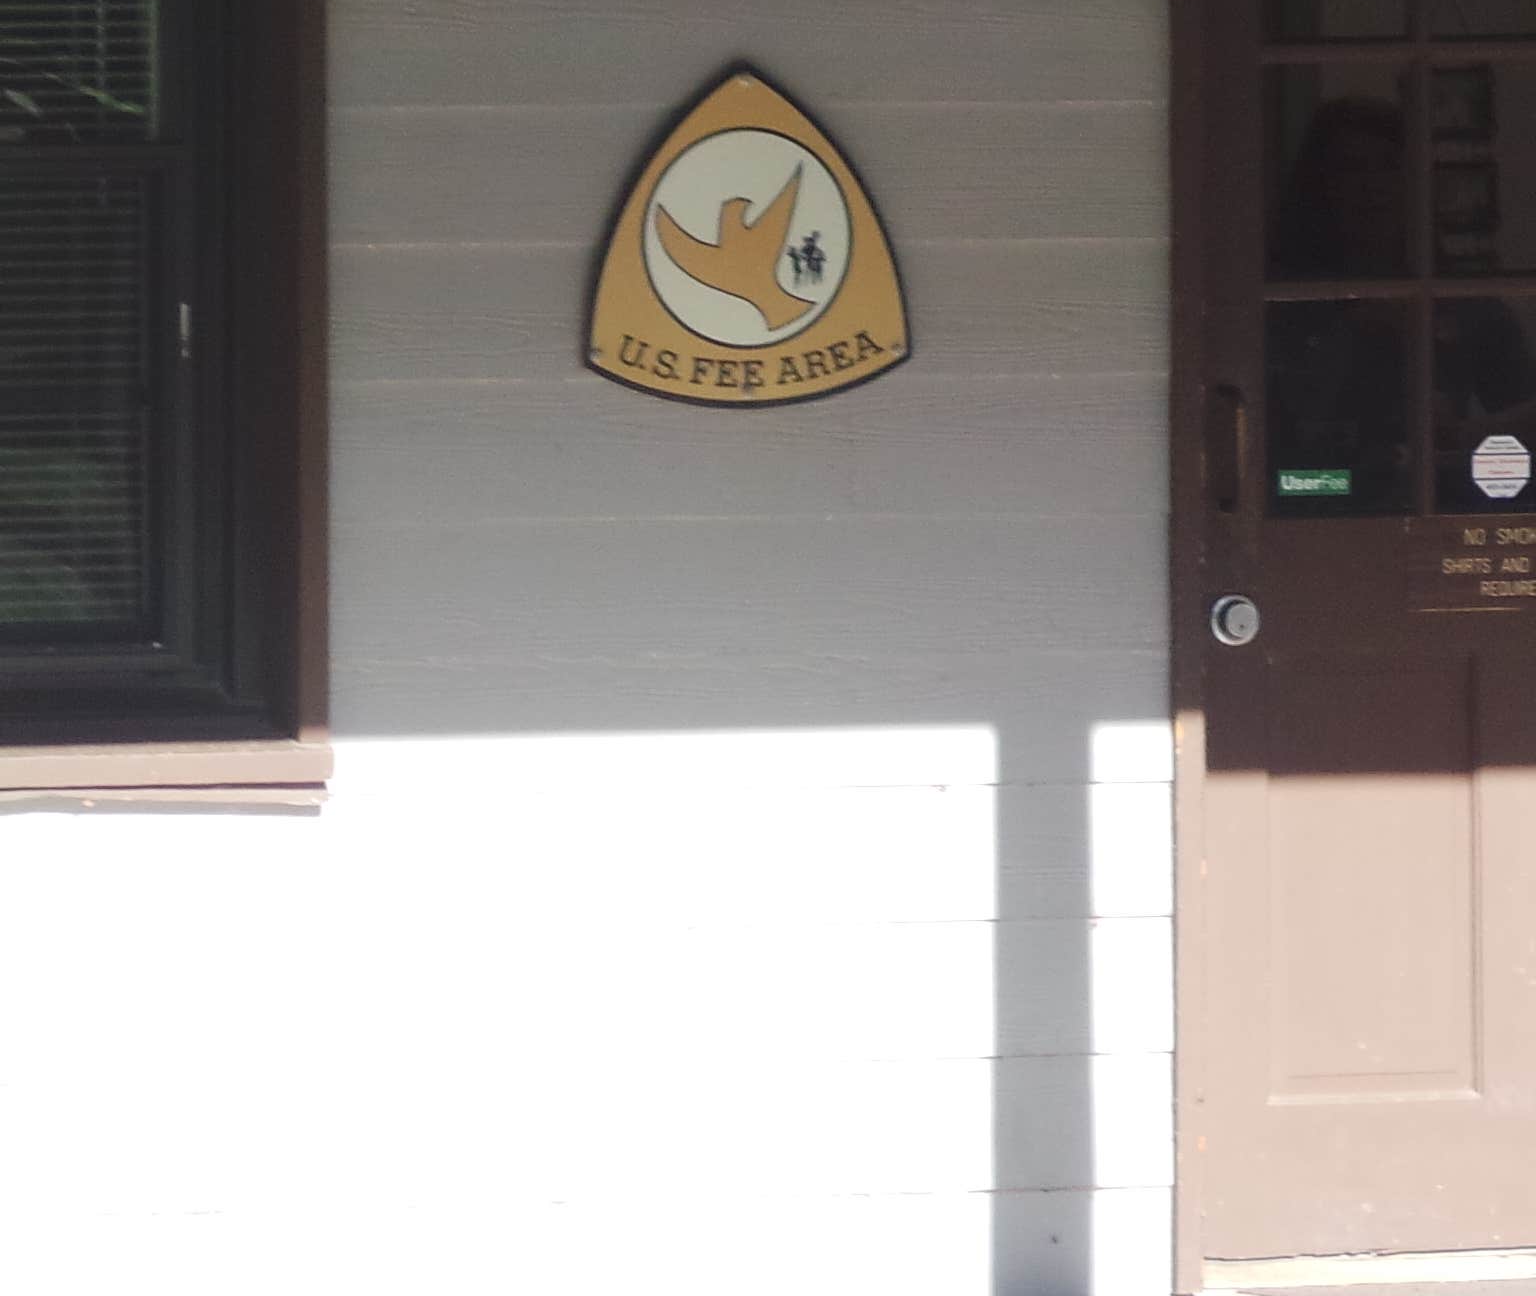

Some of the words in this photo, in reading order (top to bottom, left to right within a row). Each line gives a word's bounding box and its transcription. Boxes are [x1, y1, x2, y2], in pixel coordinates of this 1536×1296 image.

[689, 358, 766, 388] FEE
[776, 330, 884, 384] AREA
[1463, 528, 1487, 545] NO
[1442, 558, 1491, 574] SHIRTS
[1500, 557, 1530, 572] AND
